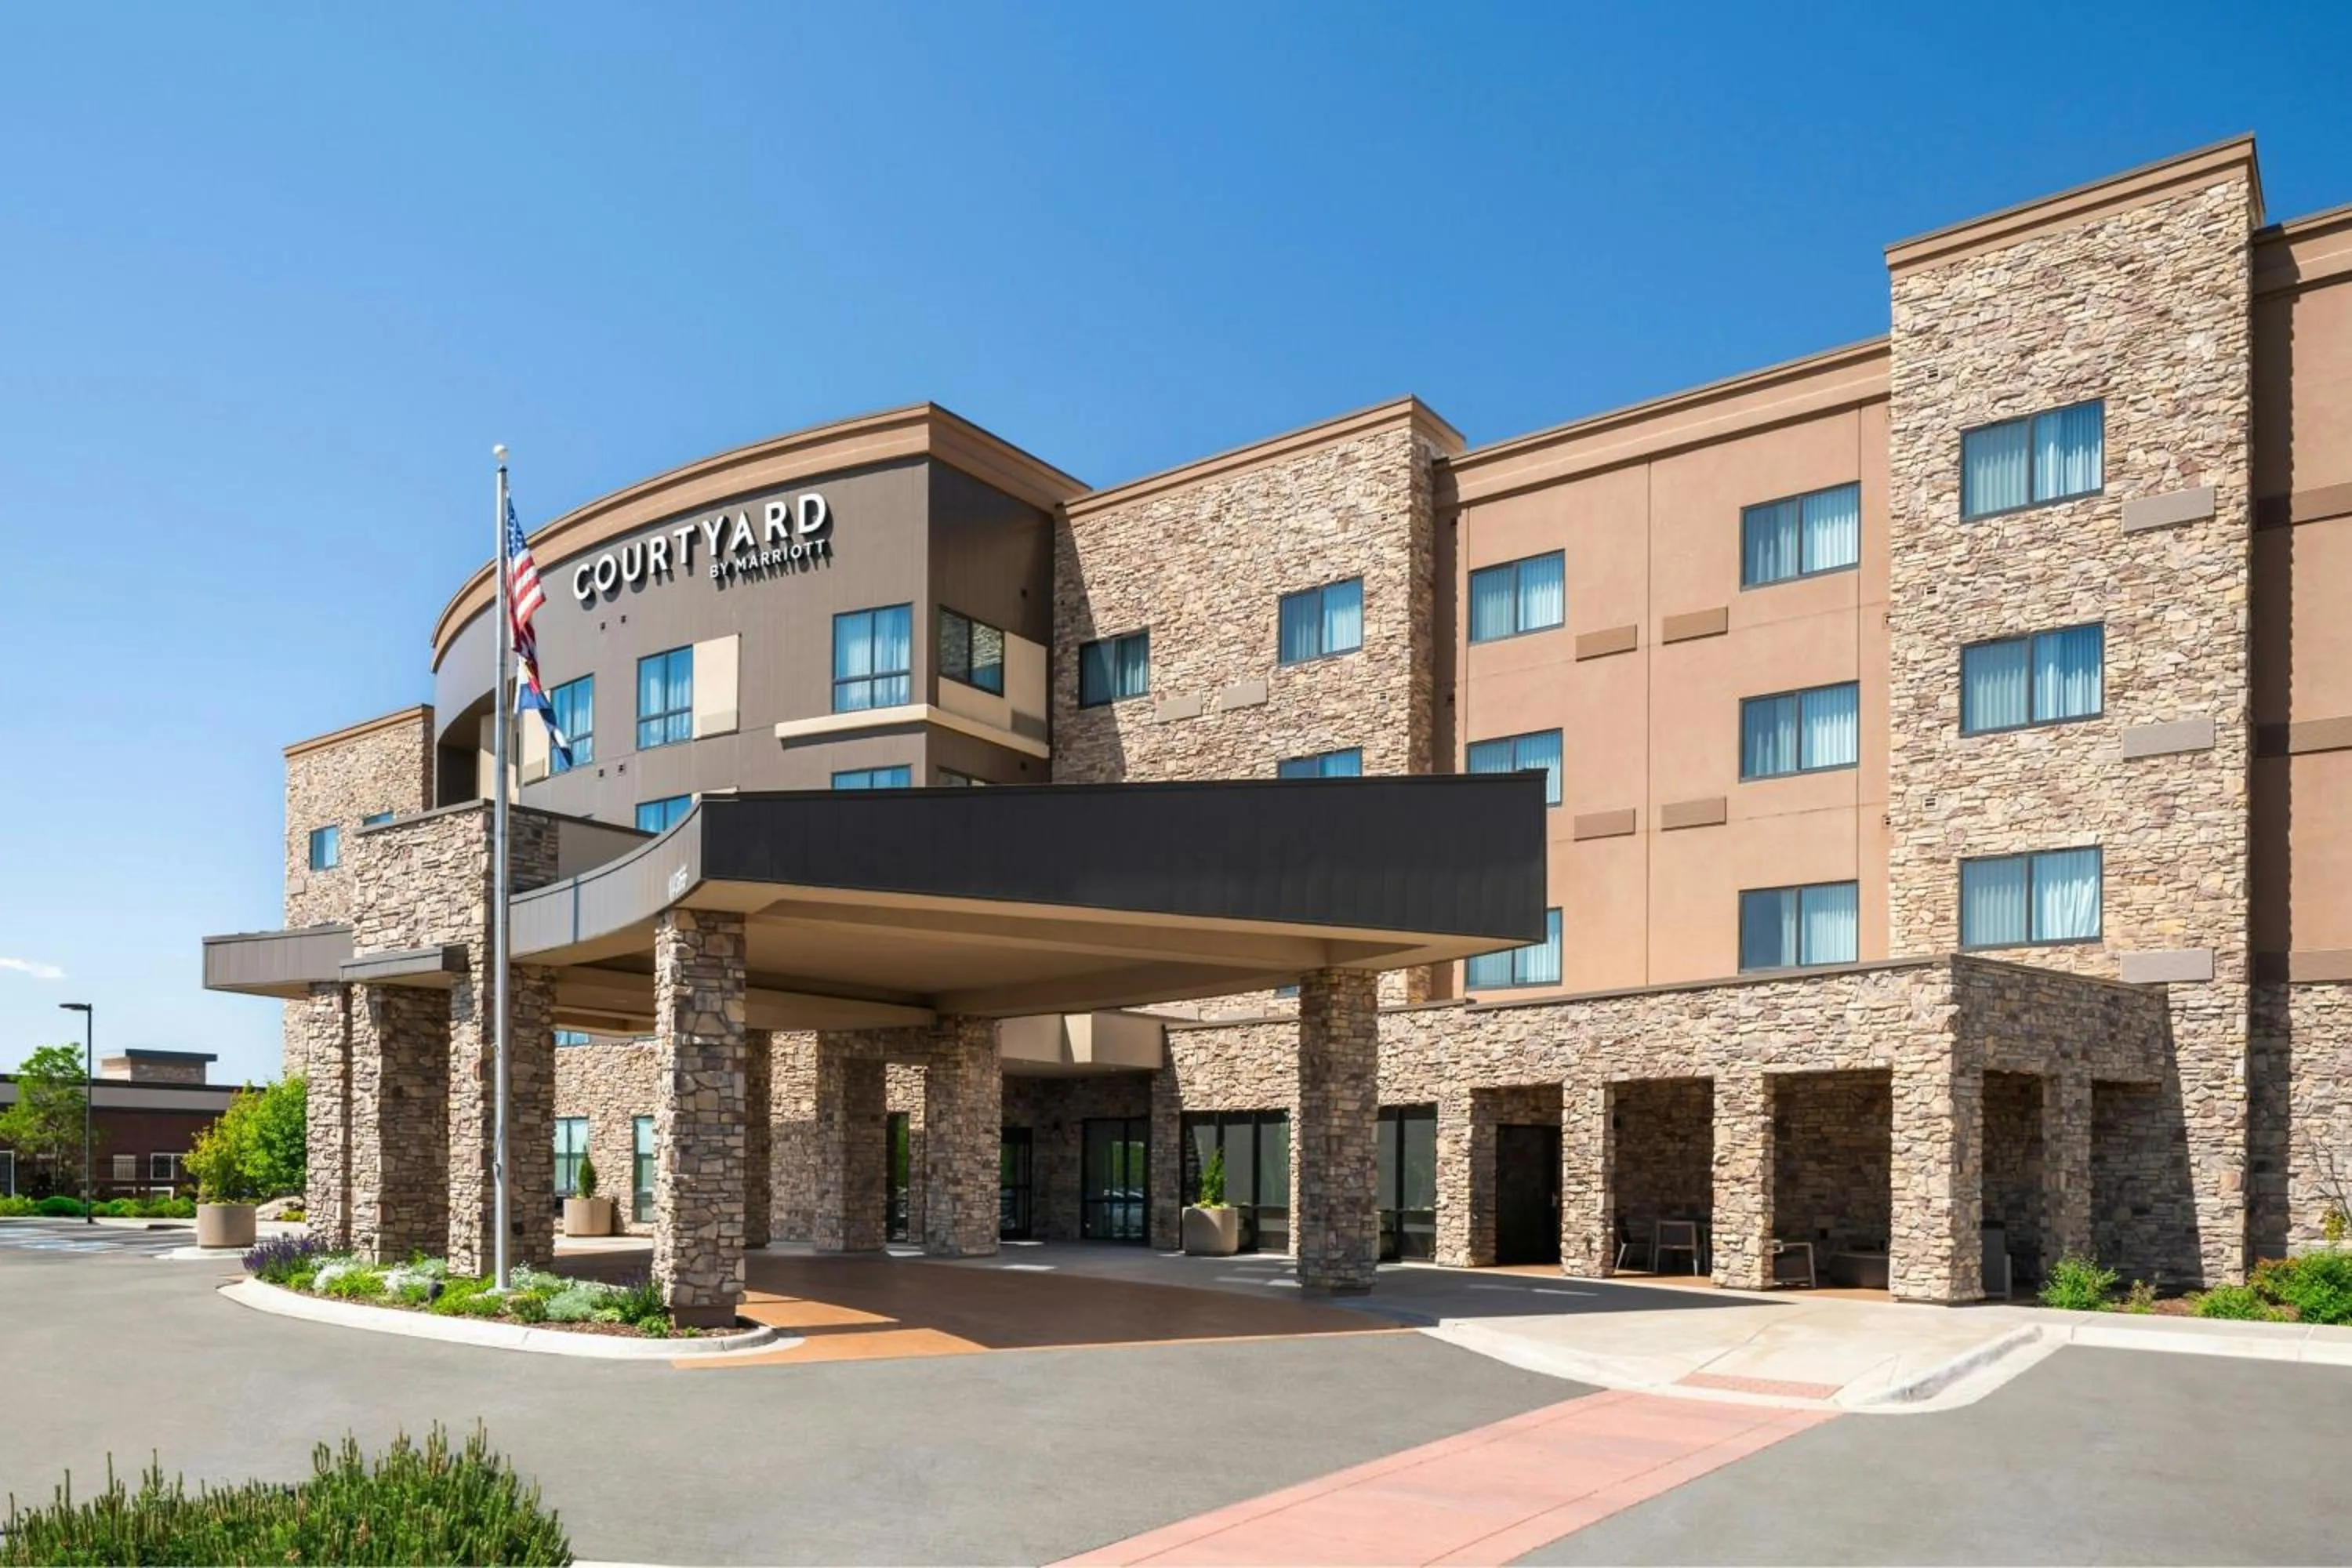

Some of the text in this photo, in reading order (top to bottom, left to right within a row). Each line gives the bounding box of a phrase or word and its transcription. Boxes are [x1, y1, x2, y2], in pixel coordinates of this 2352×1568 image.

[573, 493, 826, 600] COURTYARD
[710, 539, 826, 579] BY MARRIOTT
